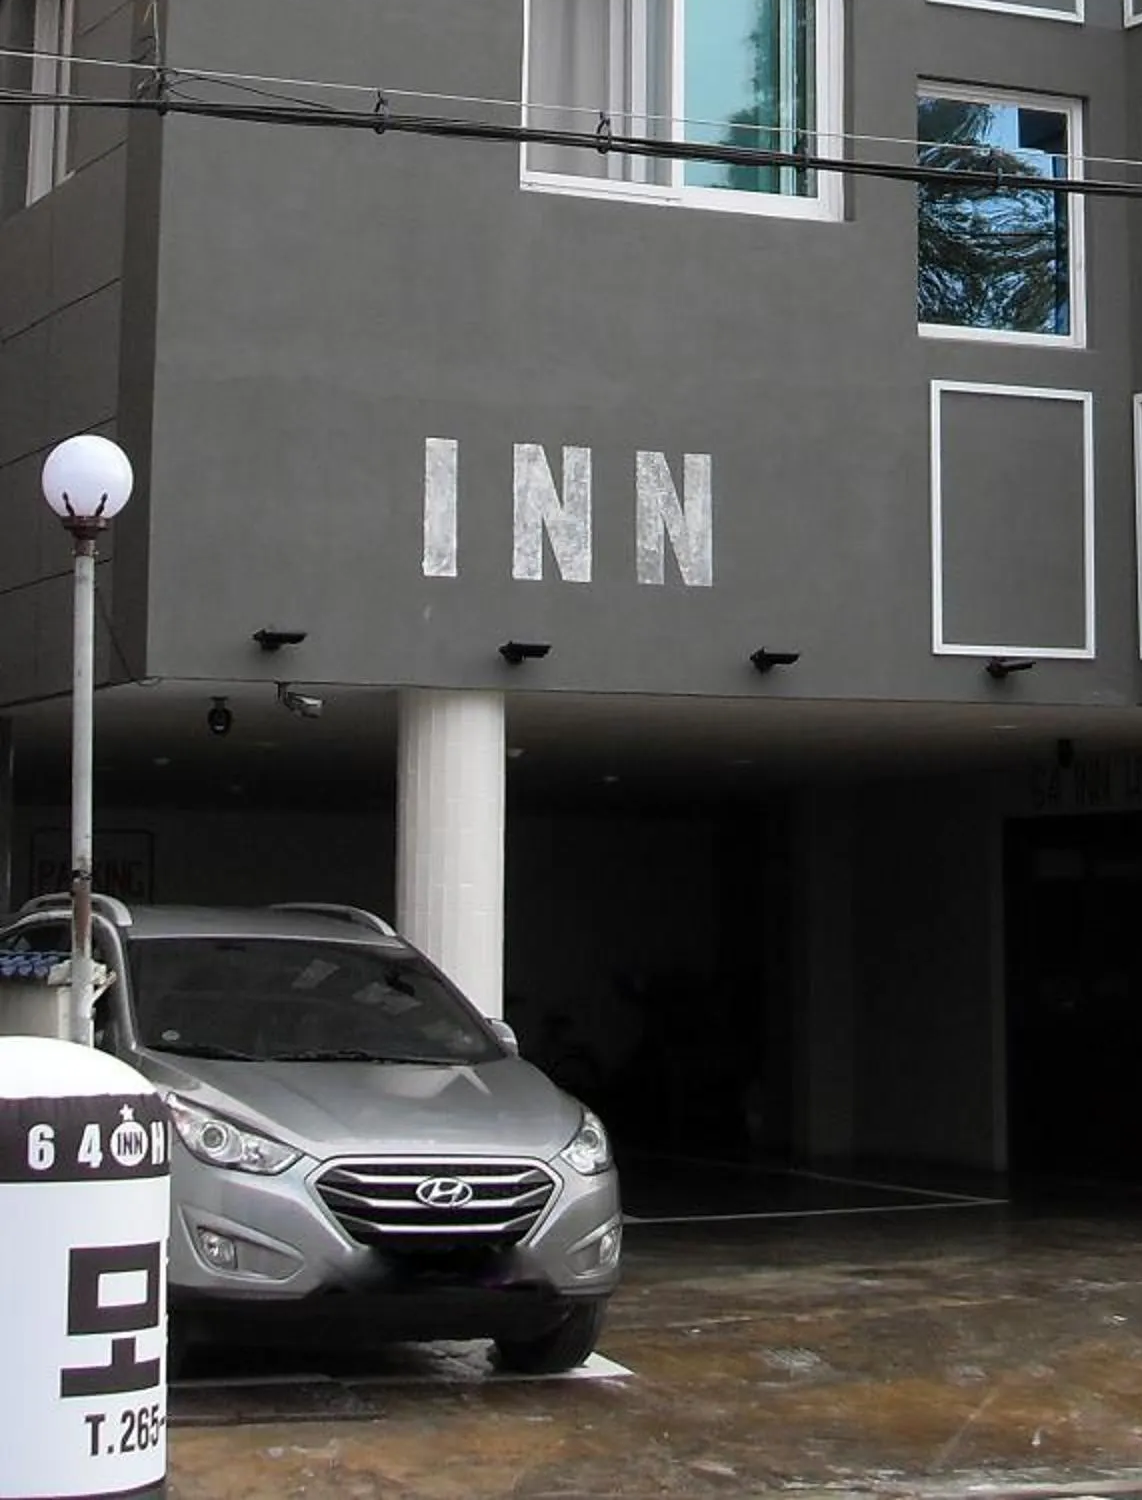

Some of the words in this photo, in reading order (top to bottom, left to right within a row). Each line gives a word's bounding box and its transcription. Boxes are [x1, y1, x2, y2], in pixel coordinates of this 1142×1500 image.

[422, 437, 712, 587] INN
[37, 858, 146, 898] PAKING
[151, 1119, 172, 1166] H
